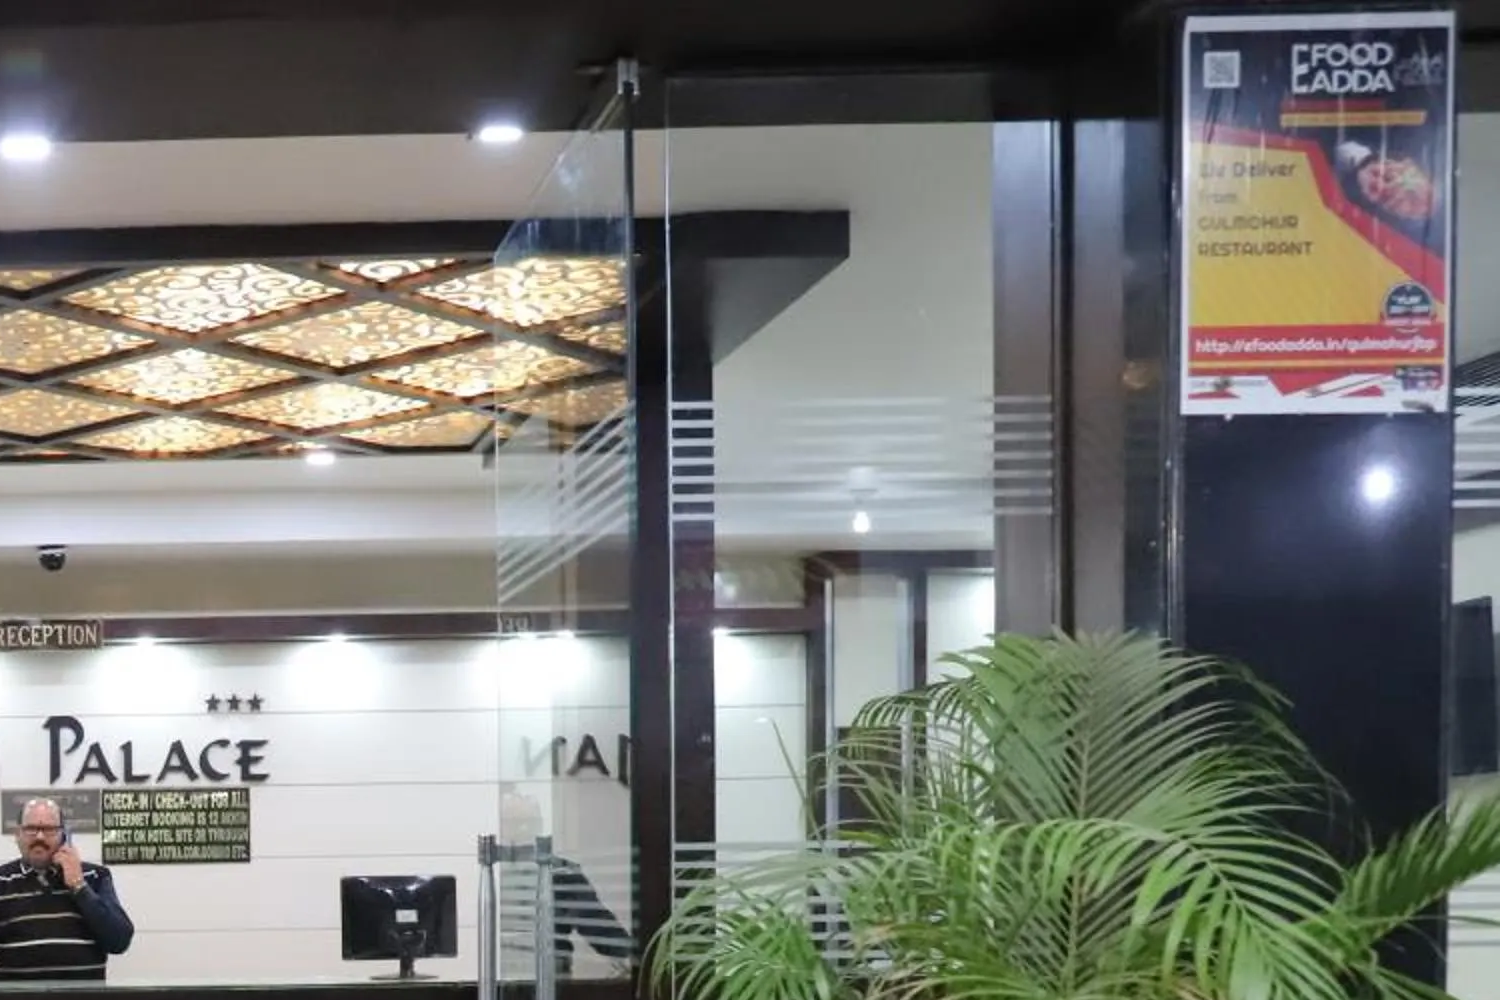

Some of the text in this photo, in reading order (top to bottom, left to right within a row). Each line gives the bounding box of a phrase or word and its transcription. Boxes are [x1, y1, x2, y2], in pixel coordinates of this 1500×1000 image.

[1233, 161, 1296, 178] Deliver
[1198, 215, 1298, 231] GULMOHUR
[1198, 241, 1314, 257] RESTAURANT
[43, 715, 270, 785] PALACE
[104, 793, 149, 810] CHECK-IN
[156, 792, 208, 809] CHECK-OUT
[211, 791, 228, 808] FOR
[232, 791, 248, 808] ALL
[104, 812, 150, 827] INTERNET
[152, 811, 195, 826] BOOKING
[197, 811, 206, 825] IS
[104, 829, 132, 844] DIRECT
[148, 829, 173, 843] HOTEL
